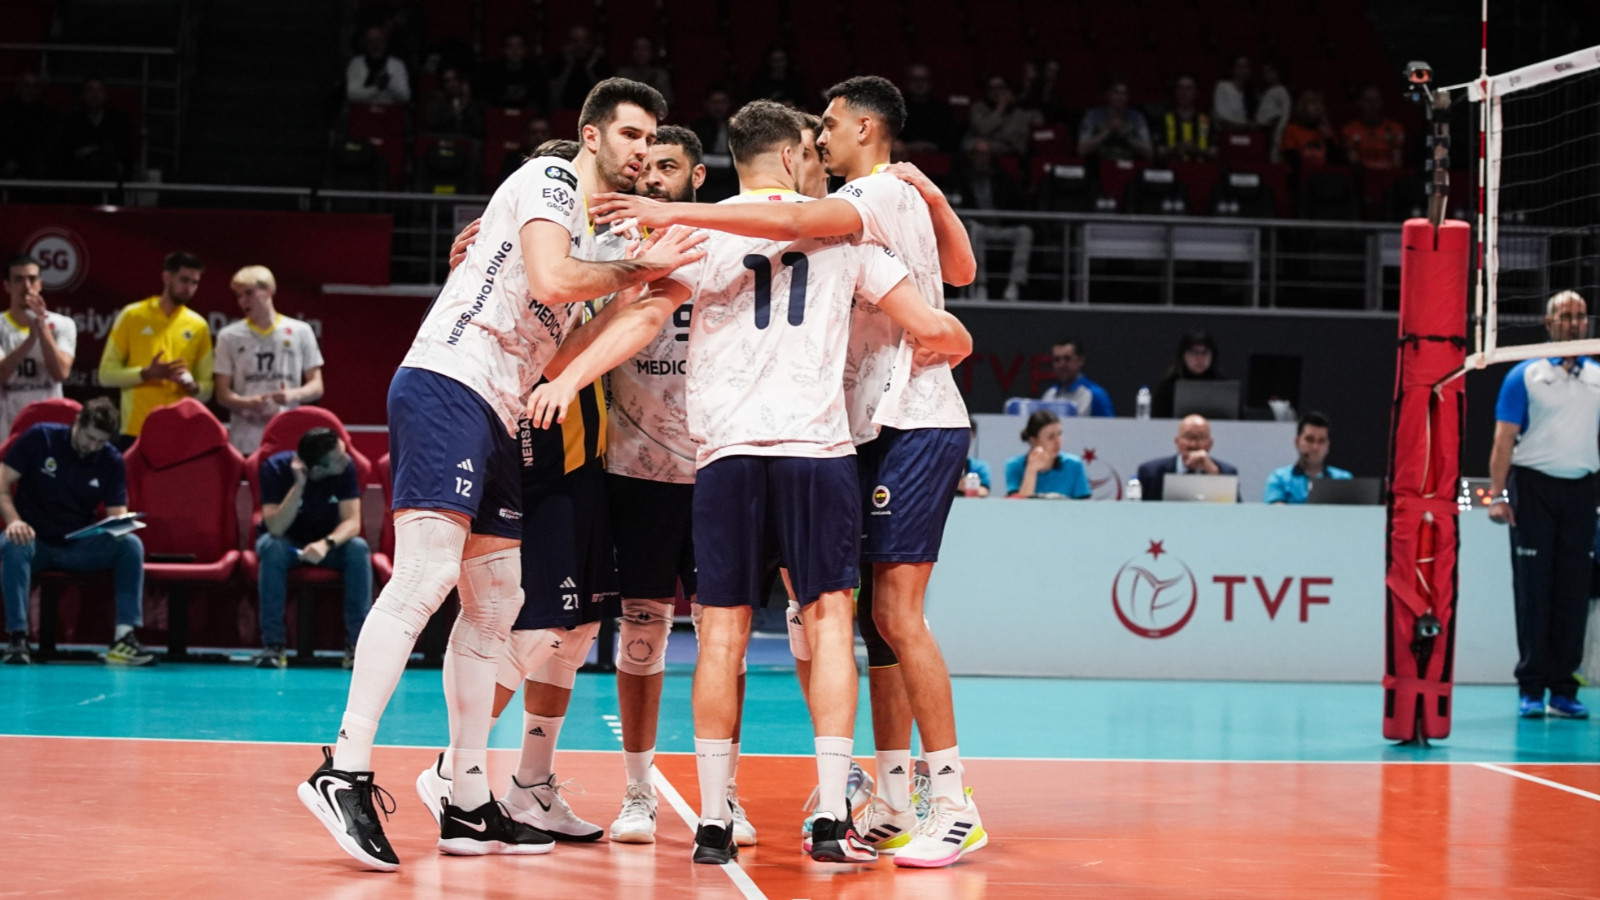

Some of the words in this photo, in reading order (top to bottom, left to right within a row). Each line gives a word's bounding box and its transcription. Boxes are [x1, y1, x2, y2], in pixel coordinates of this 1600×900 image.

[37, 250, 69, 271] 5G
[742, 251, 809, 330] 11
[256, 352, 275, 371] 17
[961, 353, 1058, 394] TVF
[455, 476, 473, 497] 12
[562, 593, 579, 610] 21
[1212, 575, 1334, 622] TVF
